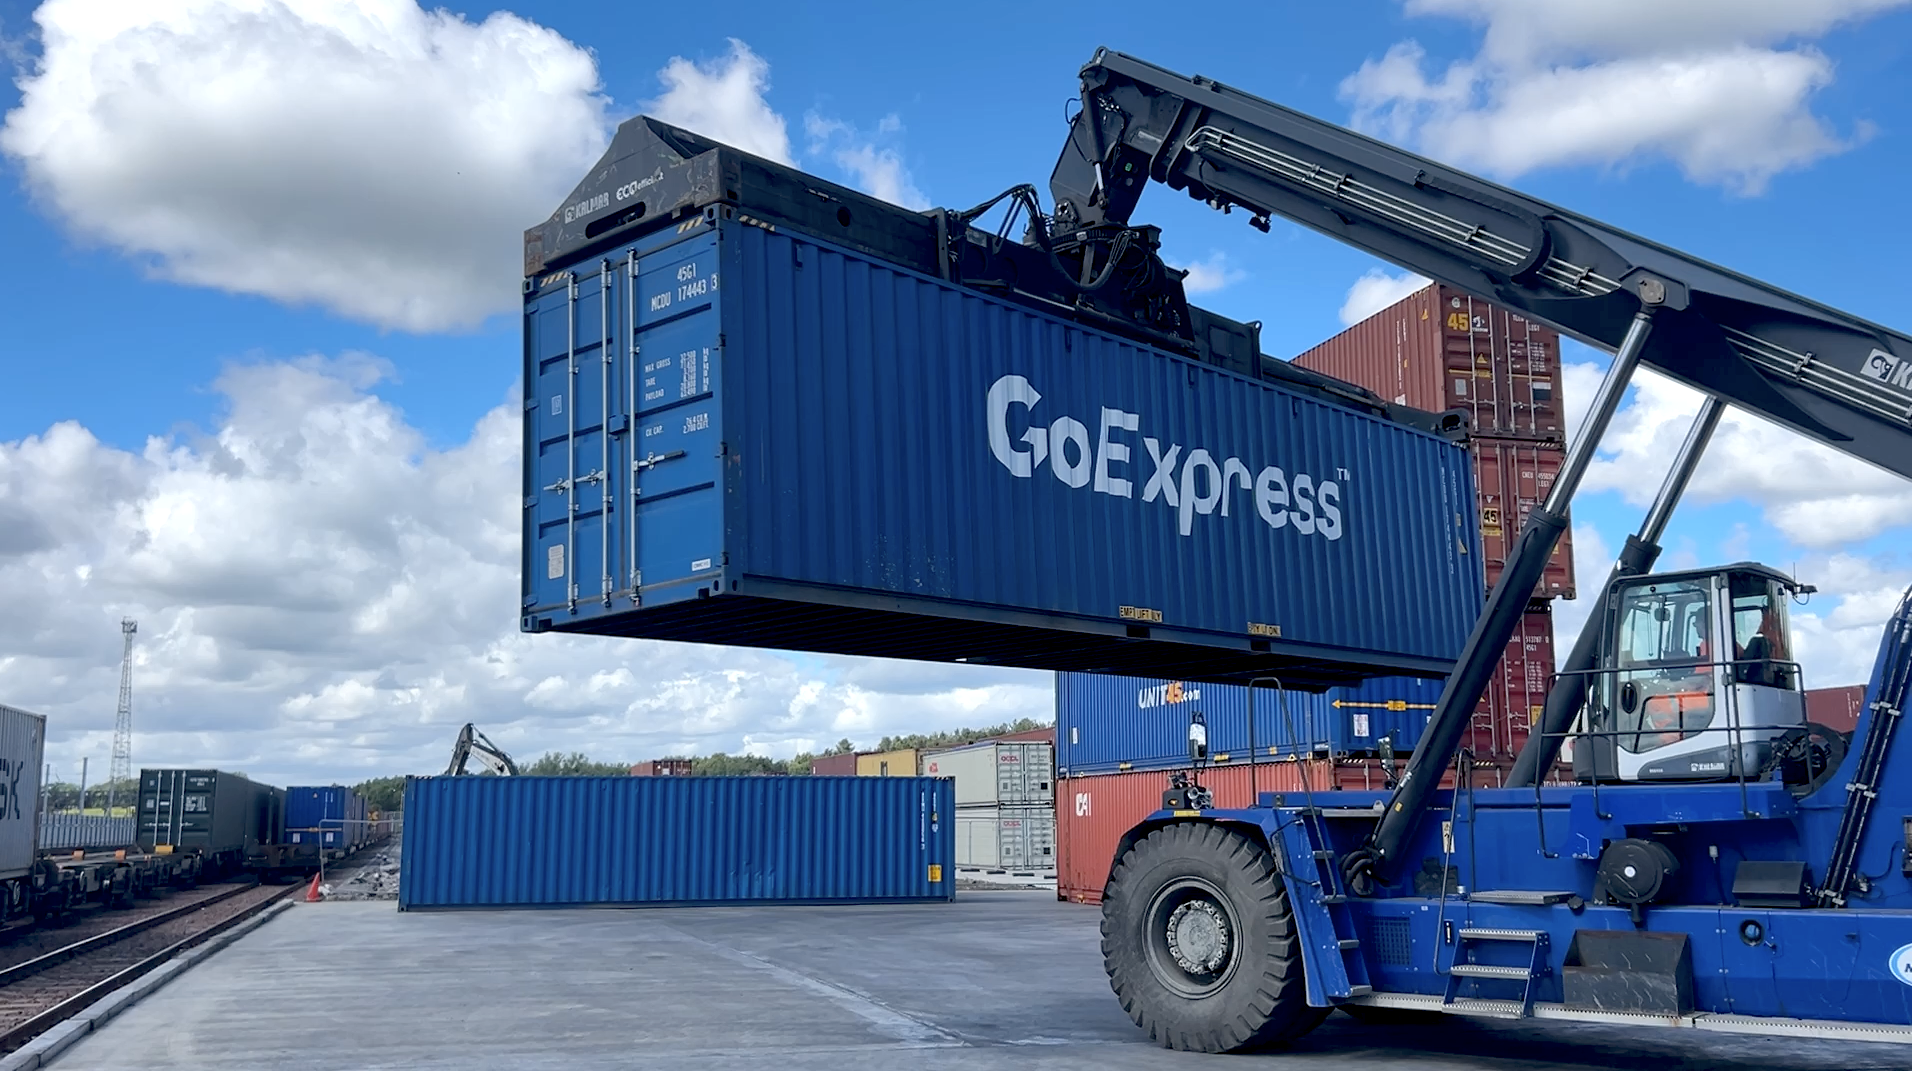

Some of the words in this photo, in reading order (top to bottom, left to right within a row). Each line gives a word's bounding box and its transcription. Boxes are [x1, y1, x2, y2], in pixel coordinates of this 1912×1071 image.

[575, 192, 609, 220] KALMAR
[677, 262, 696, 282] 45G1
[651, 291, 671, 312] MCDU
[678, 279, 707, 302] 174443
[711, 272, 719, 291] 3
[1447, 312, 1469, 331] 45
[656, 357, 671, 369] GROSS
[645, 377, 656, 388] TARE
[1890, 360, 1912, 390] K
[645, 388, 664, 401] PAYLOAD
[987, 374, 1343, 540] GoExpress
[1483, 509, 1497, 523] 45
[1075, 792, 1092, 817] CAI
